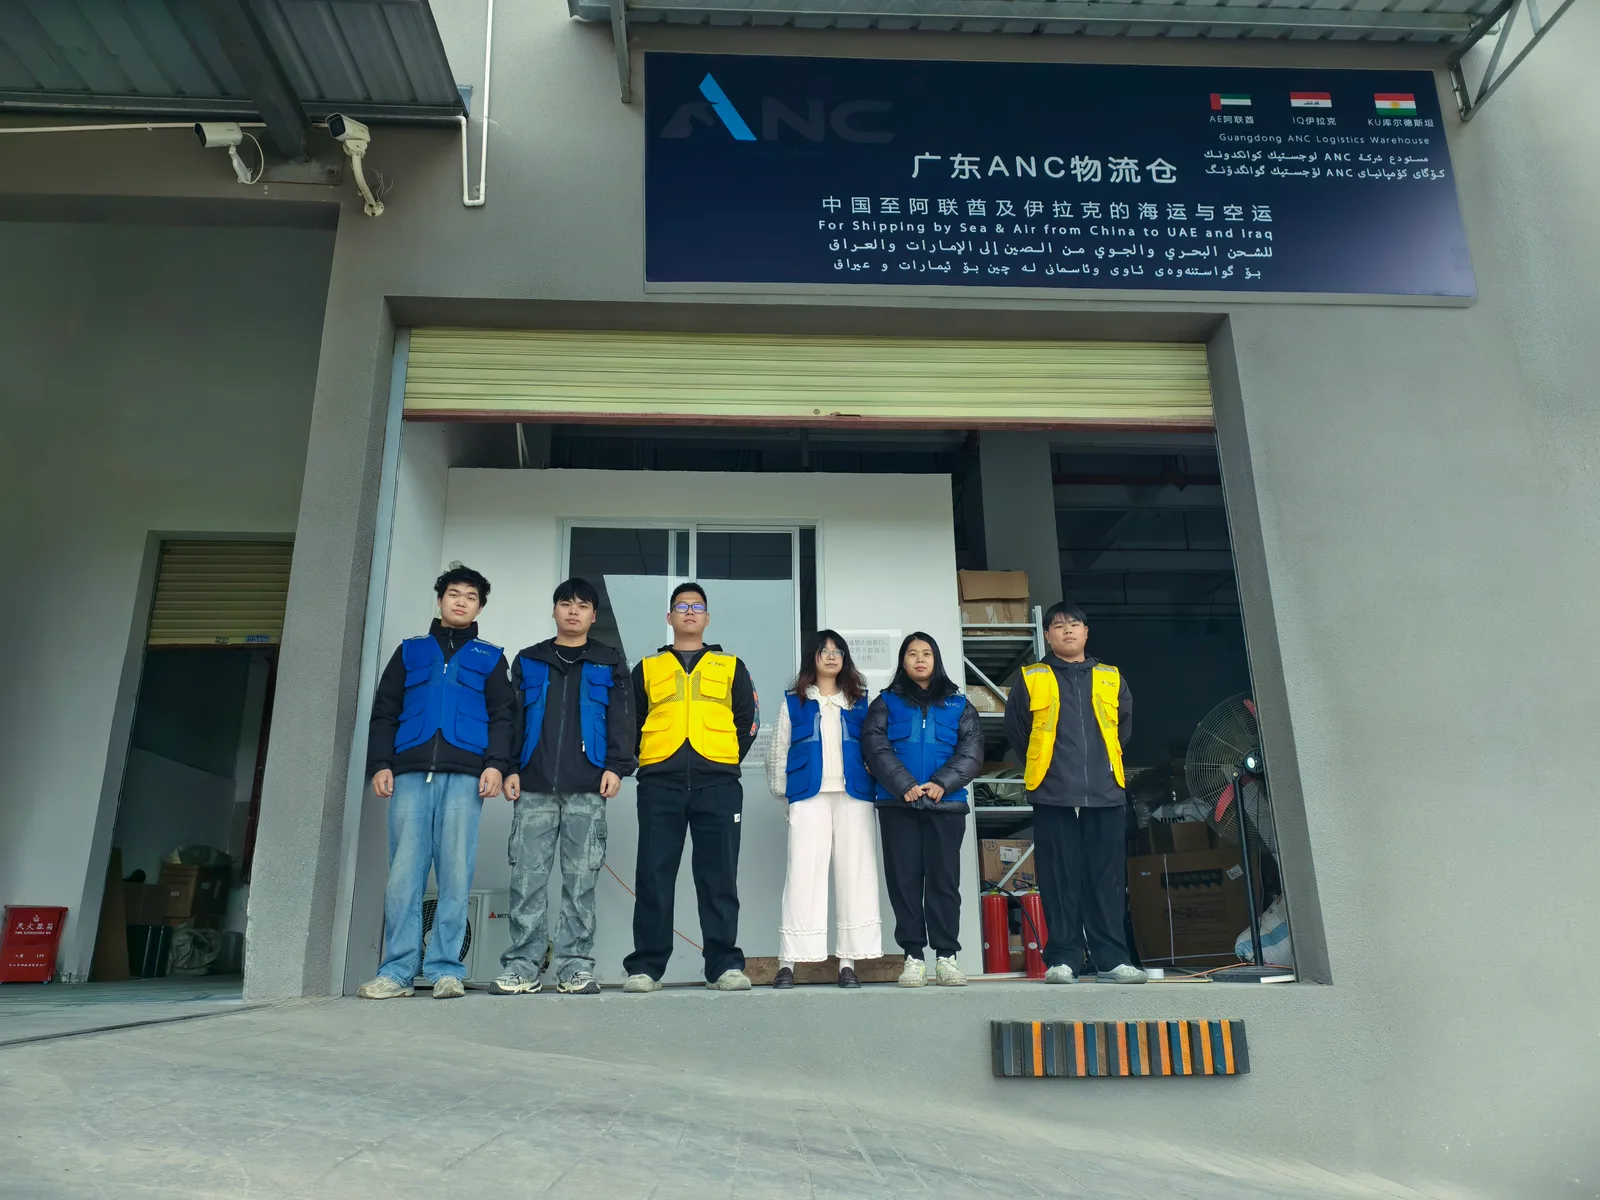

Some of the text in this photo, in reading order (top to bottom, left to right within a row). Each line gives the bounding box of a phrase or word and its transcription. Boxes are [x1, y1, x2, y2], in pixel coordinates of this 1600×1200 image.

[1293, 117, 1336, 125] IQ伊拉克
[1368, 119, 1434, 127] KU库尔德斯坦
[1219, 134, 1281, 144] Guangdong
[1316, 136, 1364, 145] Logistics
[1325, 153, 1351, 161] ANC
[912, 152, 1177, 183] 广东ANC物流仓
[1327, 169, 1353, 177] ANC
[822, 196, 1272, 222] 中国至阿联酋及伊拉克的海运与空运
[819, 220, 1272, 241] For Shipping by Sea & Air from China to UAE and Iraq
[1062, 246, 1085, 256] من
